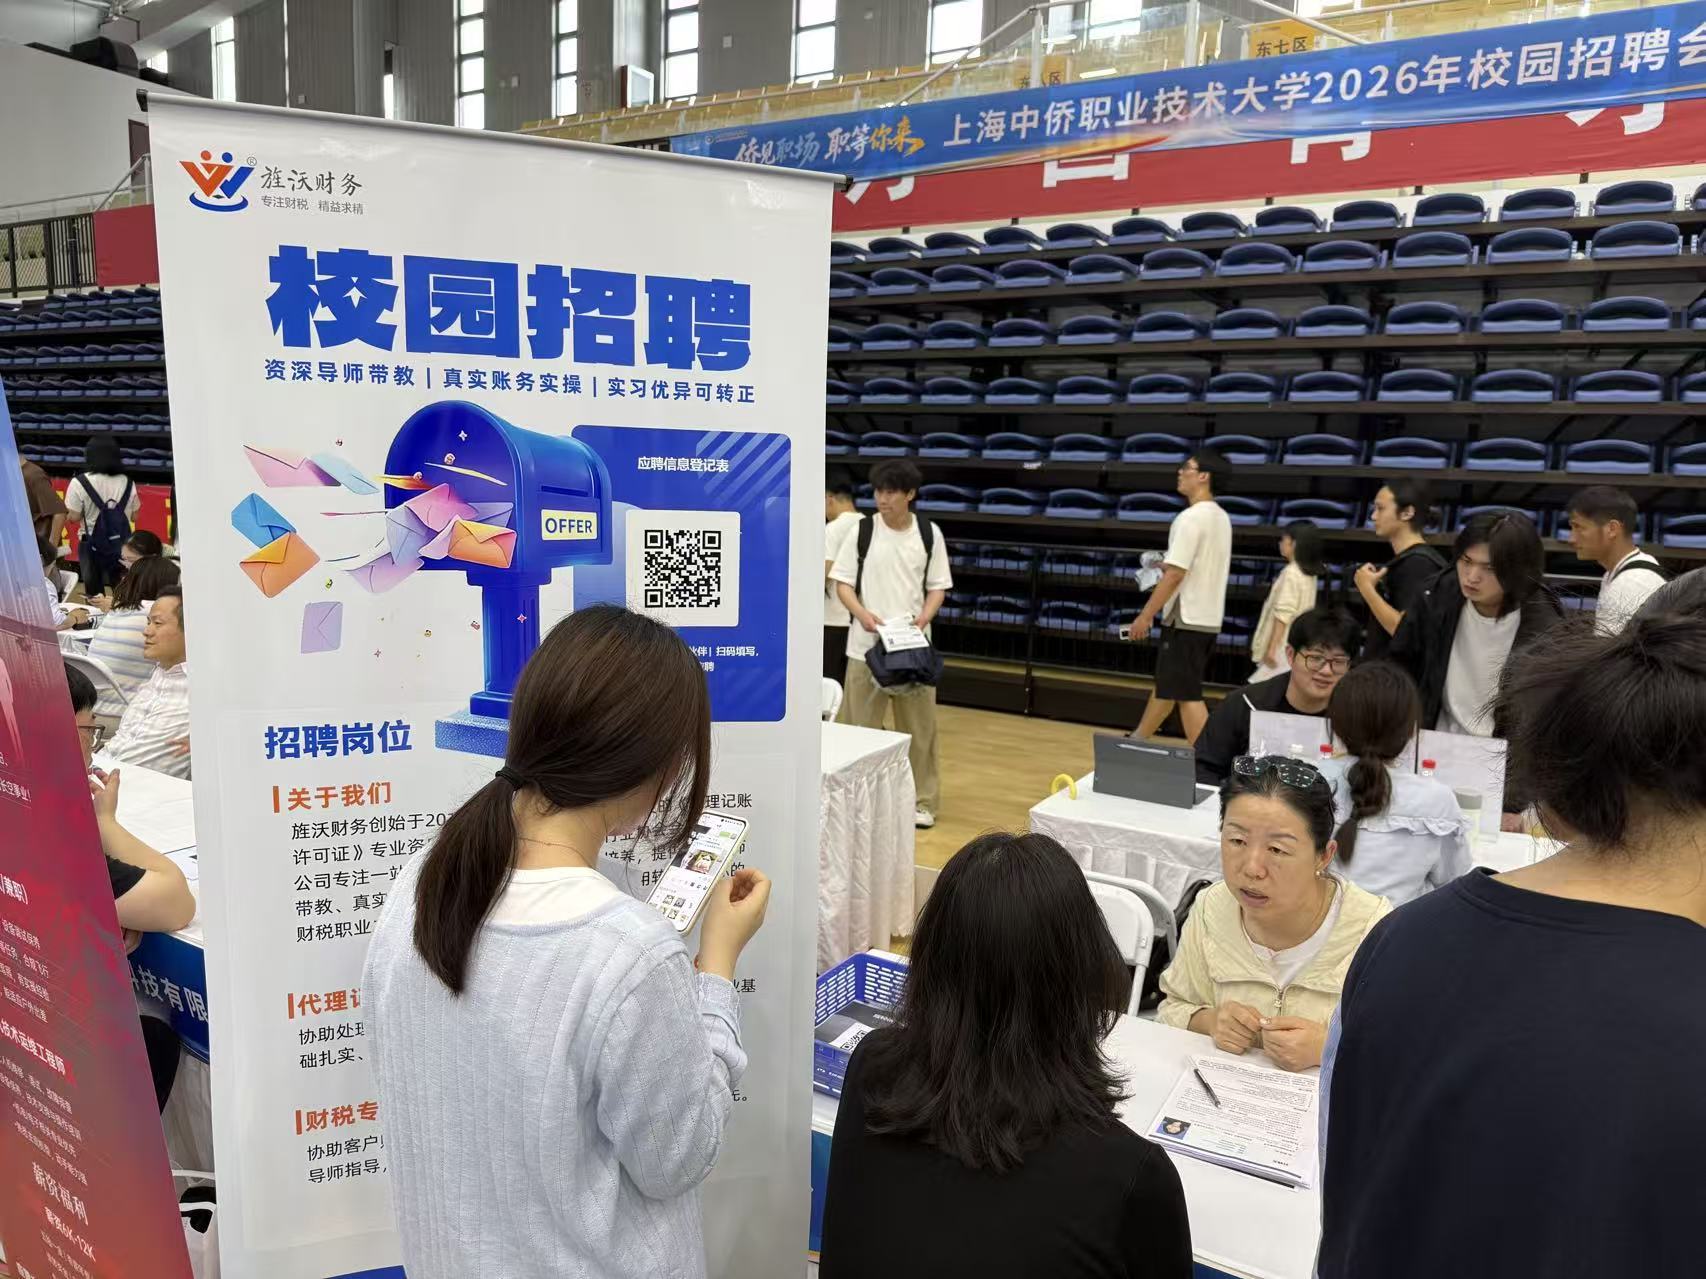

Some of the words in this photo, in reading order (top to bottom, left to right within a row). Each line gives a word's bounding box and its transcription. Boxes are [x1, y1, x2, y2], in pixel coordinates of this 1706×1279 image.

[1256, 36, 1308, 57] 东七区
[260, 166, 363, 197] 旌沃财务
[261, 195, 309, 210] 专注财税
[318, 200, 364, 215] 精益求精
[265, 244, 751, 371] 校园招聘
[264, 359, 415, 387] 资深导师带教
[443, 367, 583, 394] 真实账务实操
[607, 377, 756, 403] 实习优异可转正
[637, 456, 729, 473] 应聘信息登记表
[545, 517, 593, 534] OFFER
[265, 719, 413, 759] 招聘岗位
[287, 781, 392, 812] 关于我们
[291, 812, 453, 840] 旌沃财务创始于20
[292, 838, 432, 867] 许可证》专业资
[296, 919, 377, 944] 财税职业
[306, 1100, 379, 1132] 财税专
